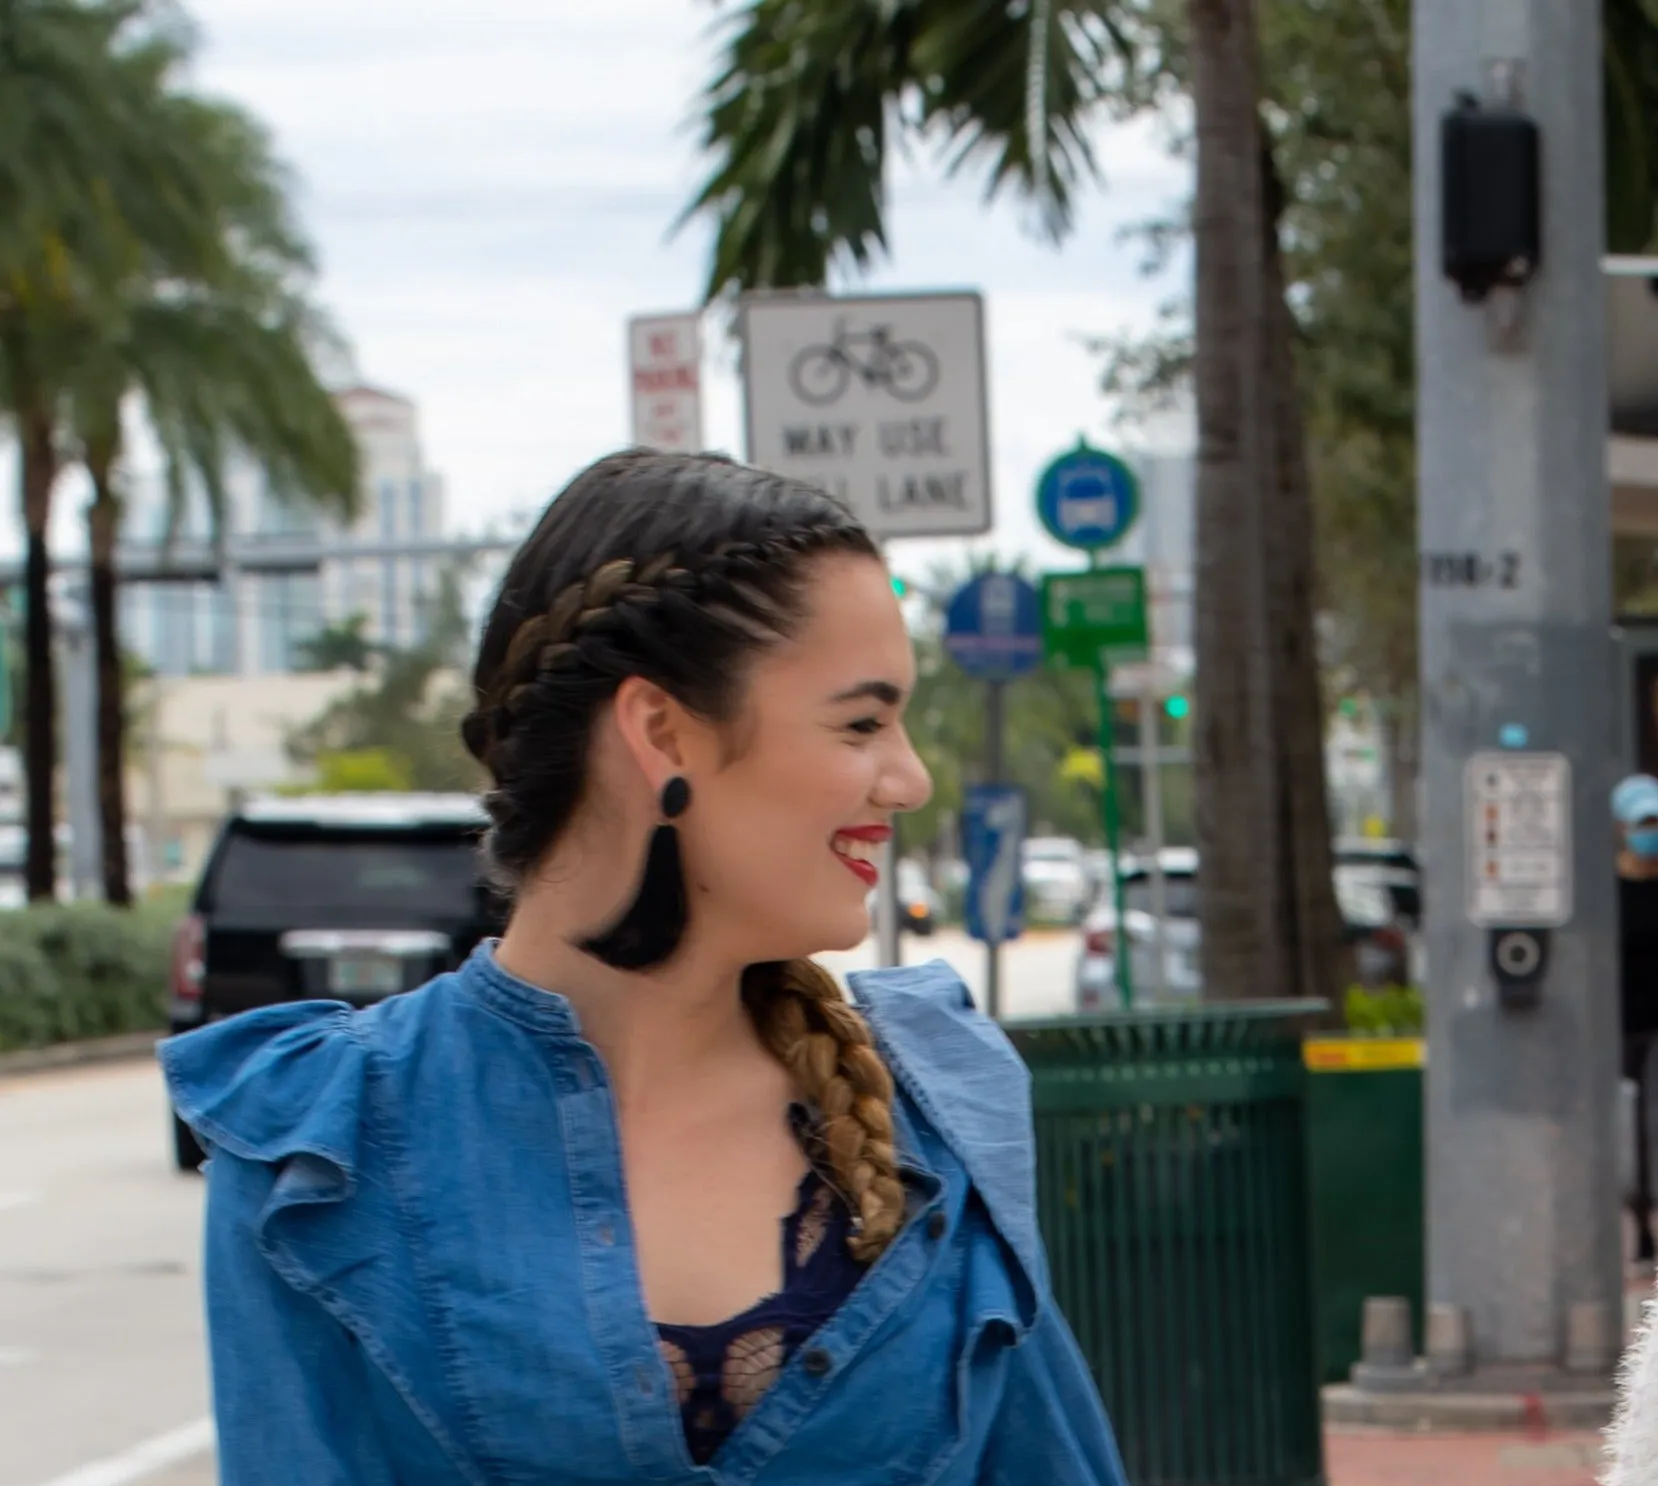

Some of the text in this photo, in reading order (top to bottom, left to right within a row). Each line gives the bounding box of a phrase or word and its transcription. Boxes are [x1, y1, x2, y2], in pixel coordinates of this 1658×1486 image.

[782, 417, 948, 458] MAY USE
[875, 470, 967, 512] LANE
